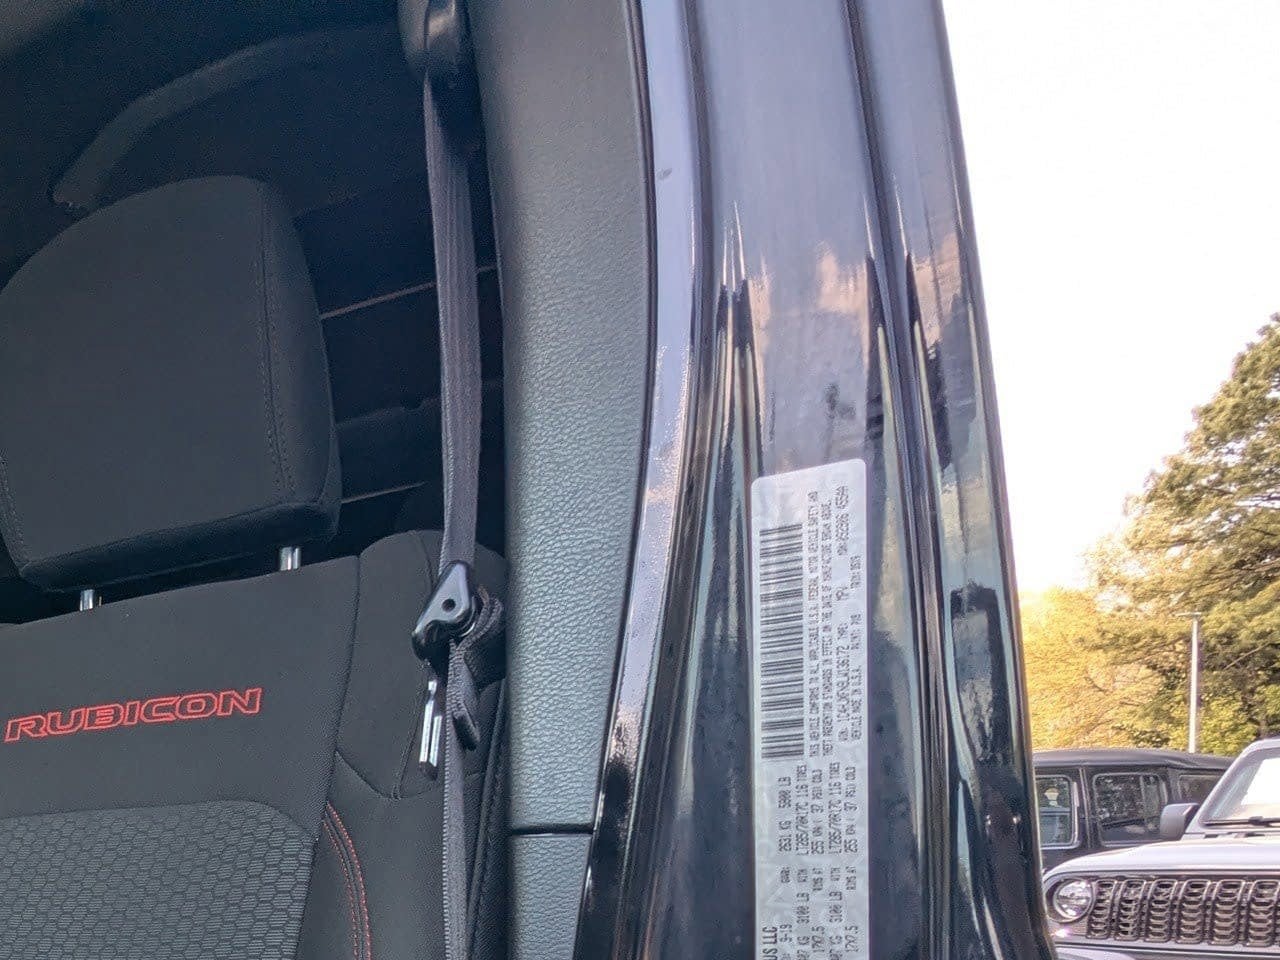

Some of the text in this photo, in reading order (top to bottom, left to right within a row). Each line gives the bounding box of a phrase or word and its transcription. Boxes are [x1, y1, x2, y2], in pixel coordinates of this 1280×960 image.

[4, 688, 262, 743] RUBICON
[778, 776, 791, 787] LB
[844, 802, 857, 811] 37
[811, 841, 824, 854] 255
[844, 839, 857, 852] 255
[797, 892, 809, 901] LB
[830, 891, 843, 901] LB
[763, 926, 777, 944] LLC
[780, 924, 792, 942] 9-19
[797, 936, 809, 945] KG
[763, 948, 777, 960] US
